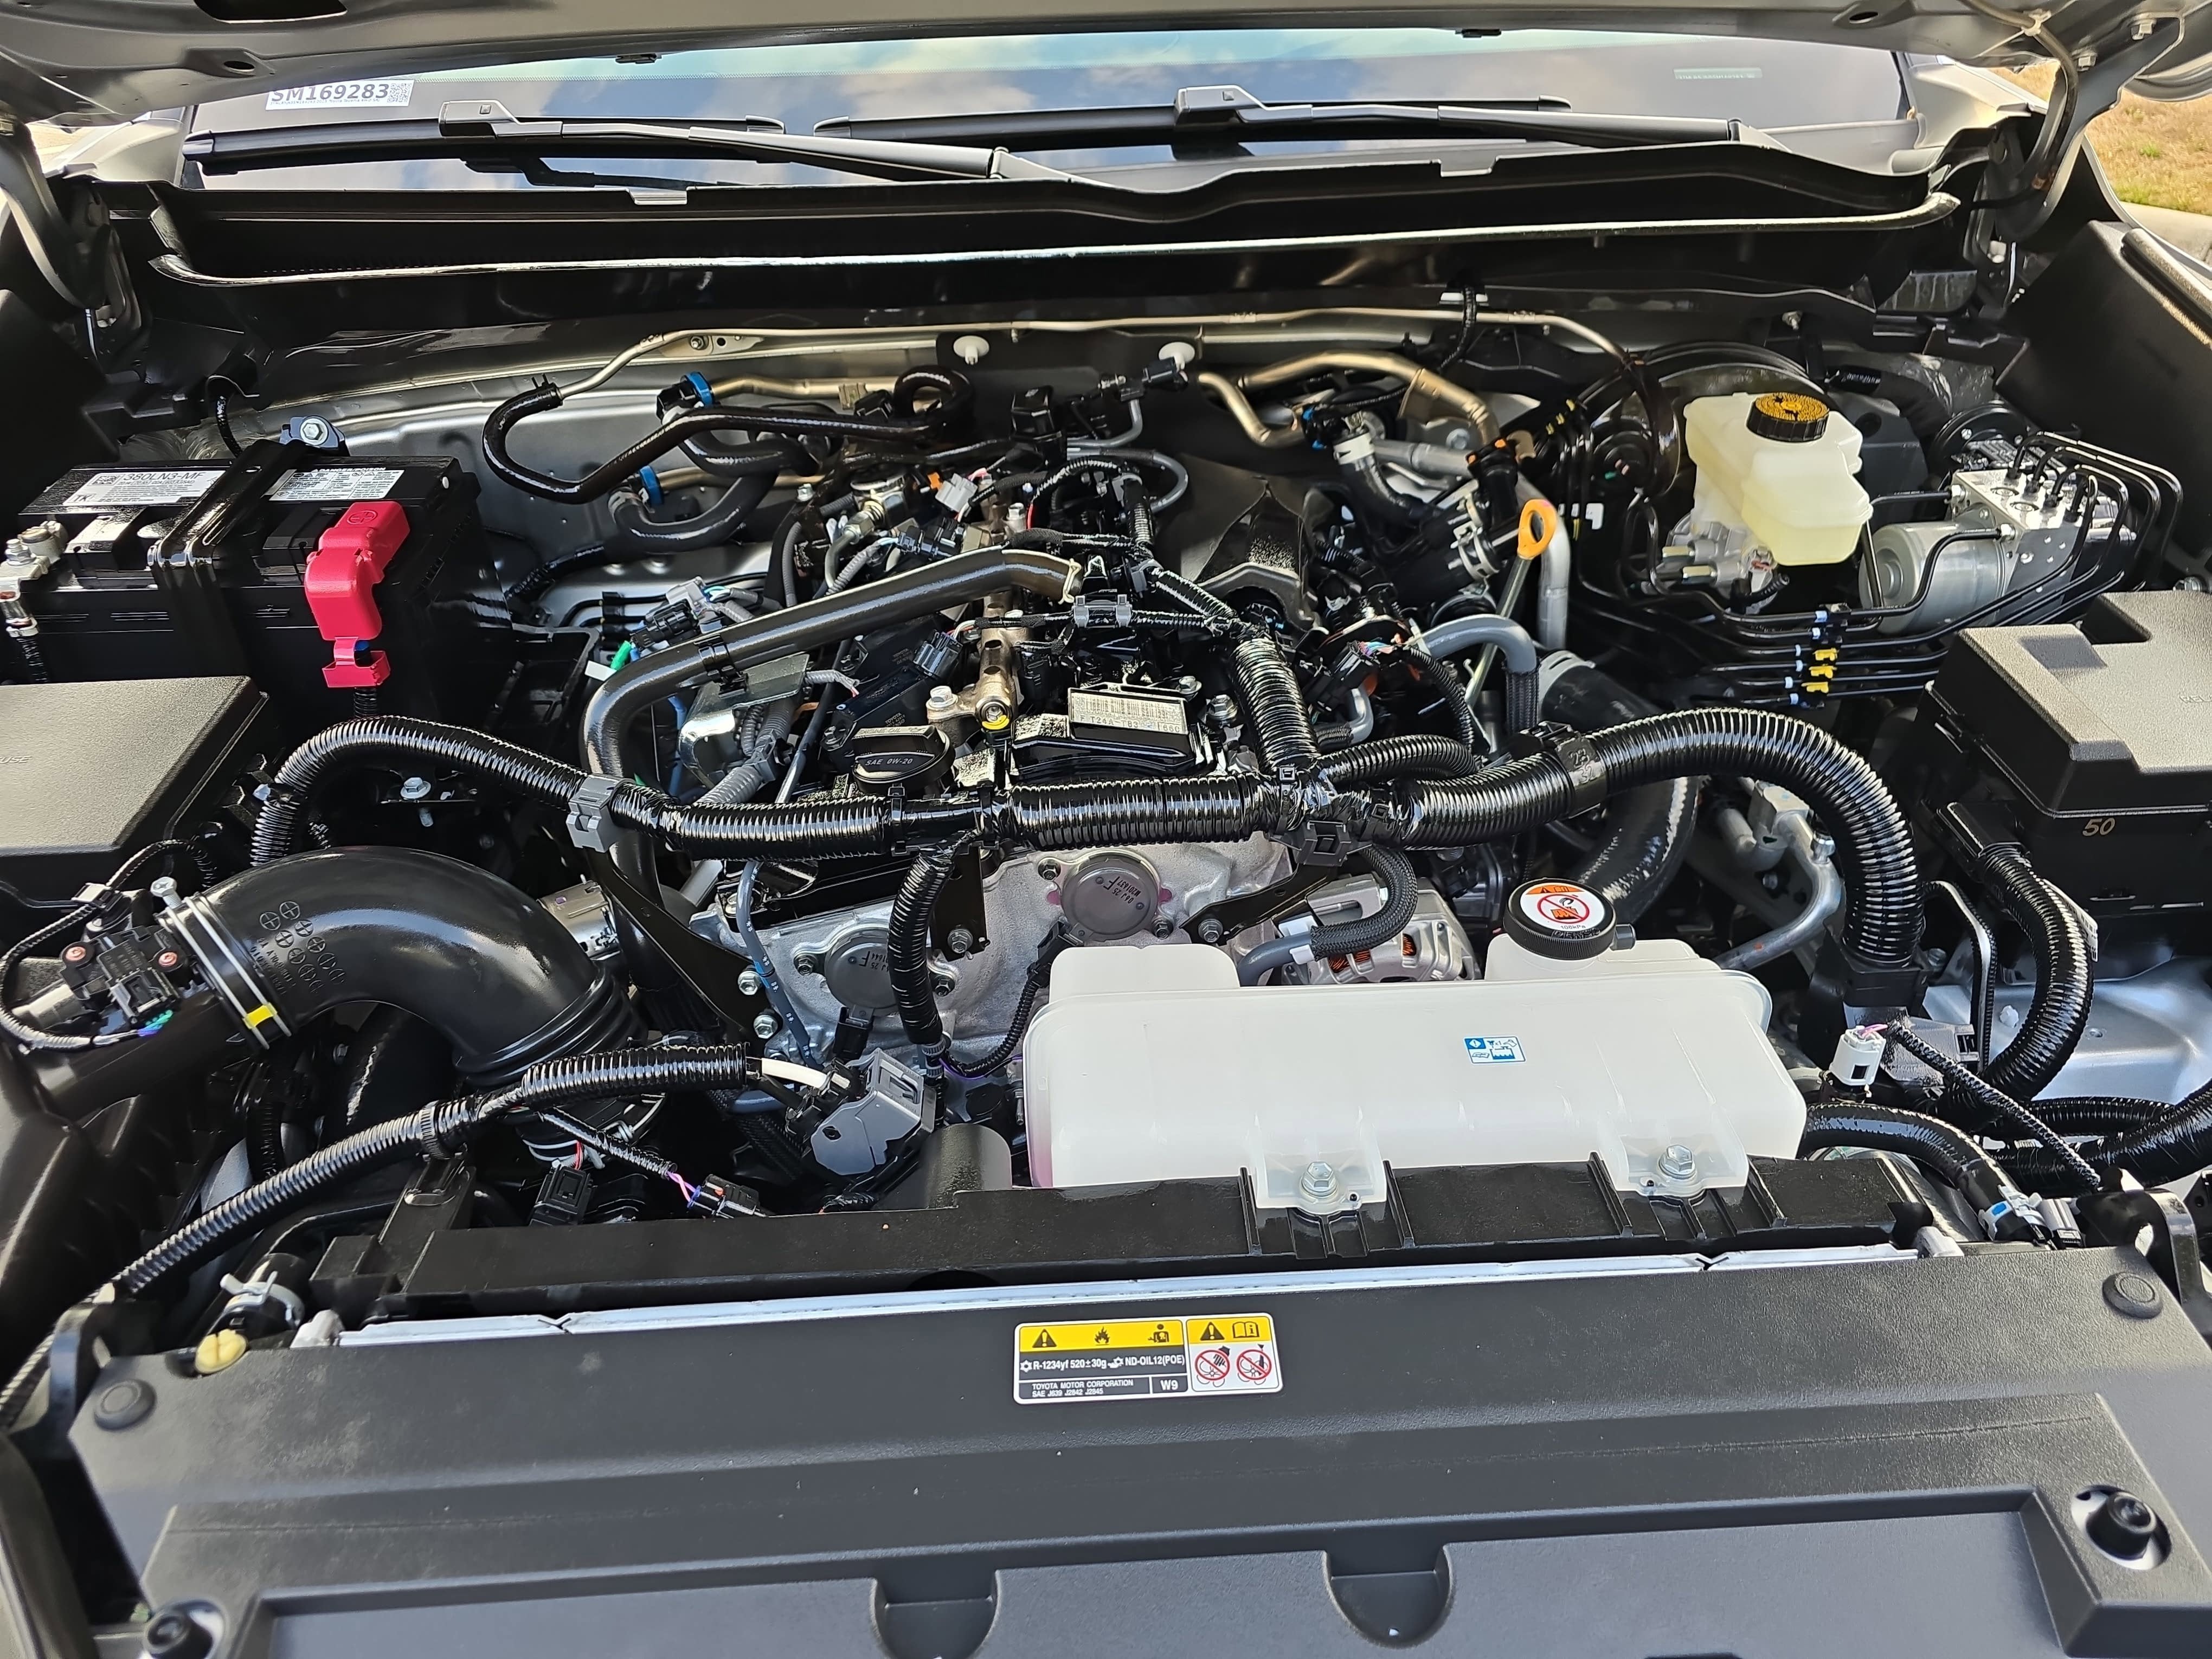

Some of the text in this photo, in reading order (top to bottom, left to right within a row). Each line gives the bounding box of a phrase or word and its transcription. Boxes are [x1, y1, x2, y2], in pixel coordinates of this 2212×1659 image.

[271, 83, 389, 101] SM169283
[123, 472, 207, 481] 380LN3-MF
[885, 712, 902, 724] TOYOTA
[0, 756, 32, 764] USE
[2082, 818, 2115, 836] 50
[1103, 876, 1120, 890] F
[859, 951, 870, 967] F
[1033, 1354, 1185, 1371] R-1234yf 520±30g ND-OIL12(POE)
[1086, 1379, 1134, 1387] CORPORATION
[1160, 1380, 1178, 1391] W9
